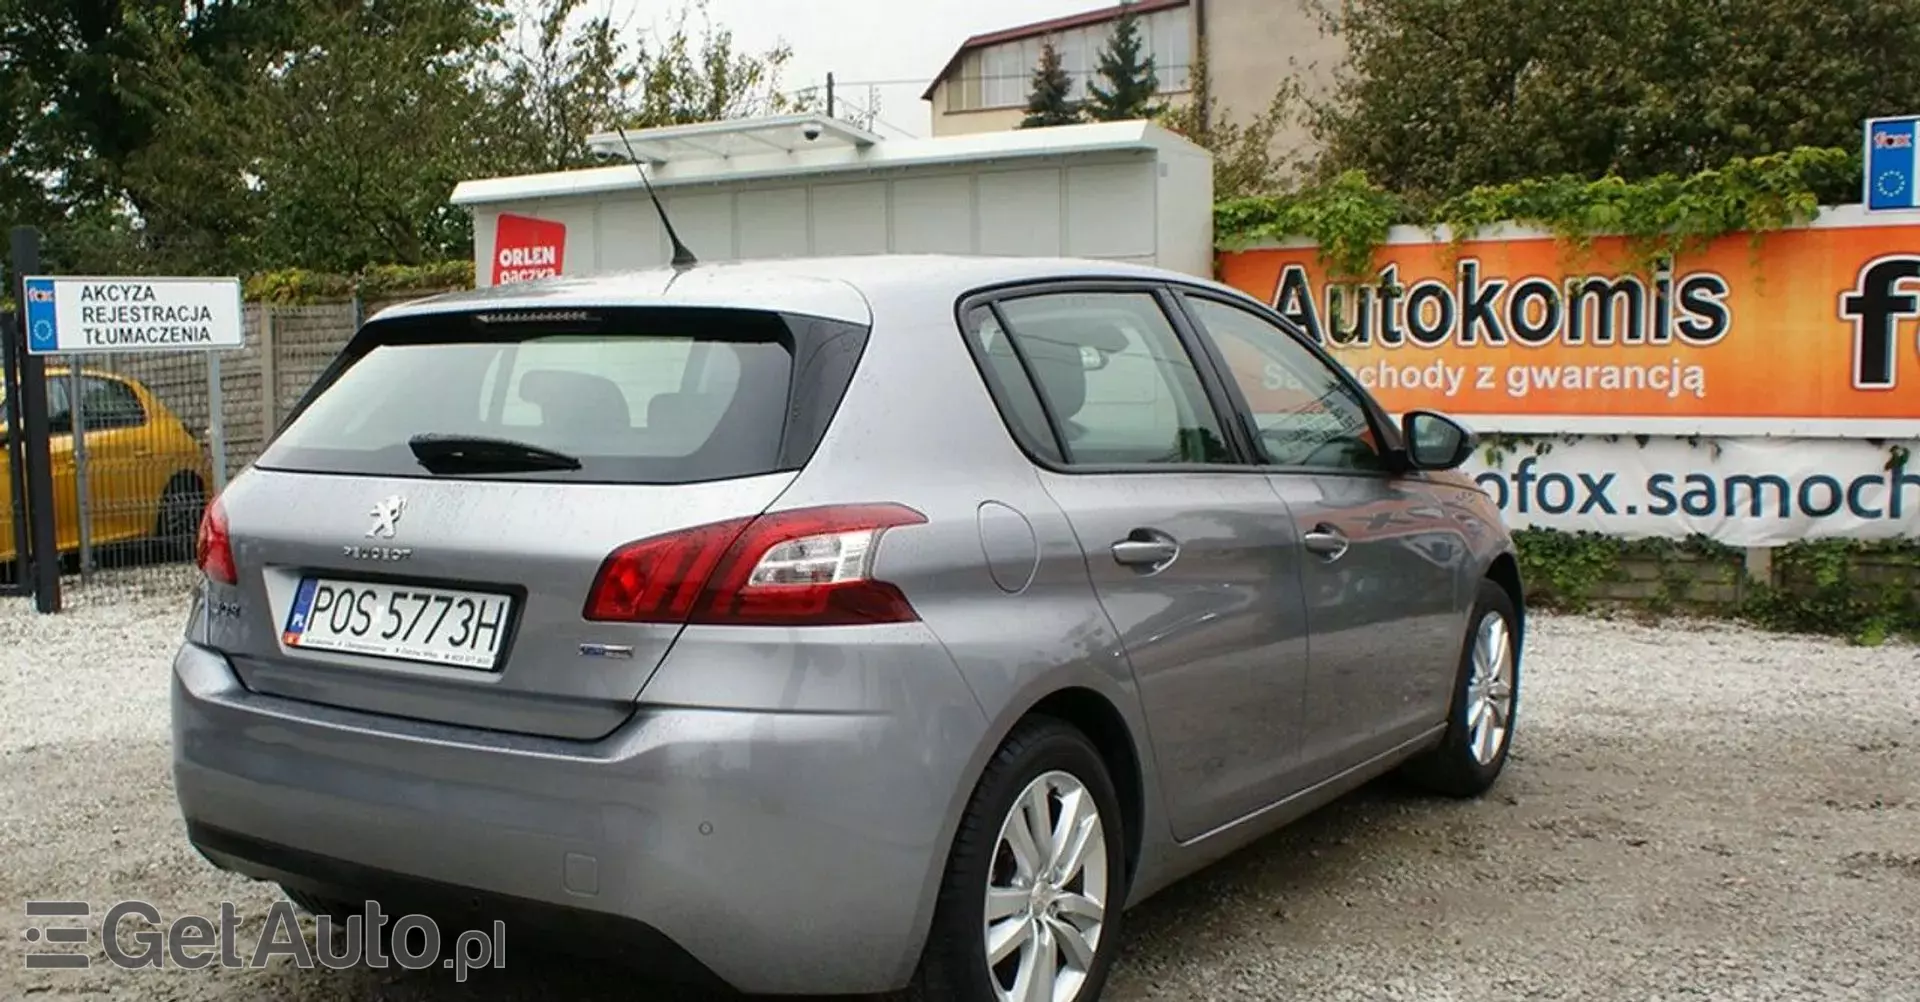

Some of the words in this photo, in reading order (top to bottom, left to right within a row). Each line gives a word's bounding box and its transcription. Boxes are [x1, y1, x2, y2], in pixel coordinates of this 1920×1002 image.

[499, 246, 556, 267] ORLEN
[81, 285, 156, 301] AKCYZA
[1272, 254, 1731, 347] Autokomis
[83, 305, 213, 323] REJESTRACJA
[84, 327, 212, 345] TŁUMACZENIA
[1475, 366, 1496, 389] z
[1507, 359, 1705, 398] gwarancją
[307, 586, 377, 637] POS
[381, 591, 505, 652] 5773H
